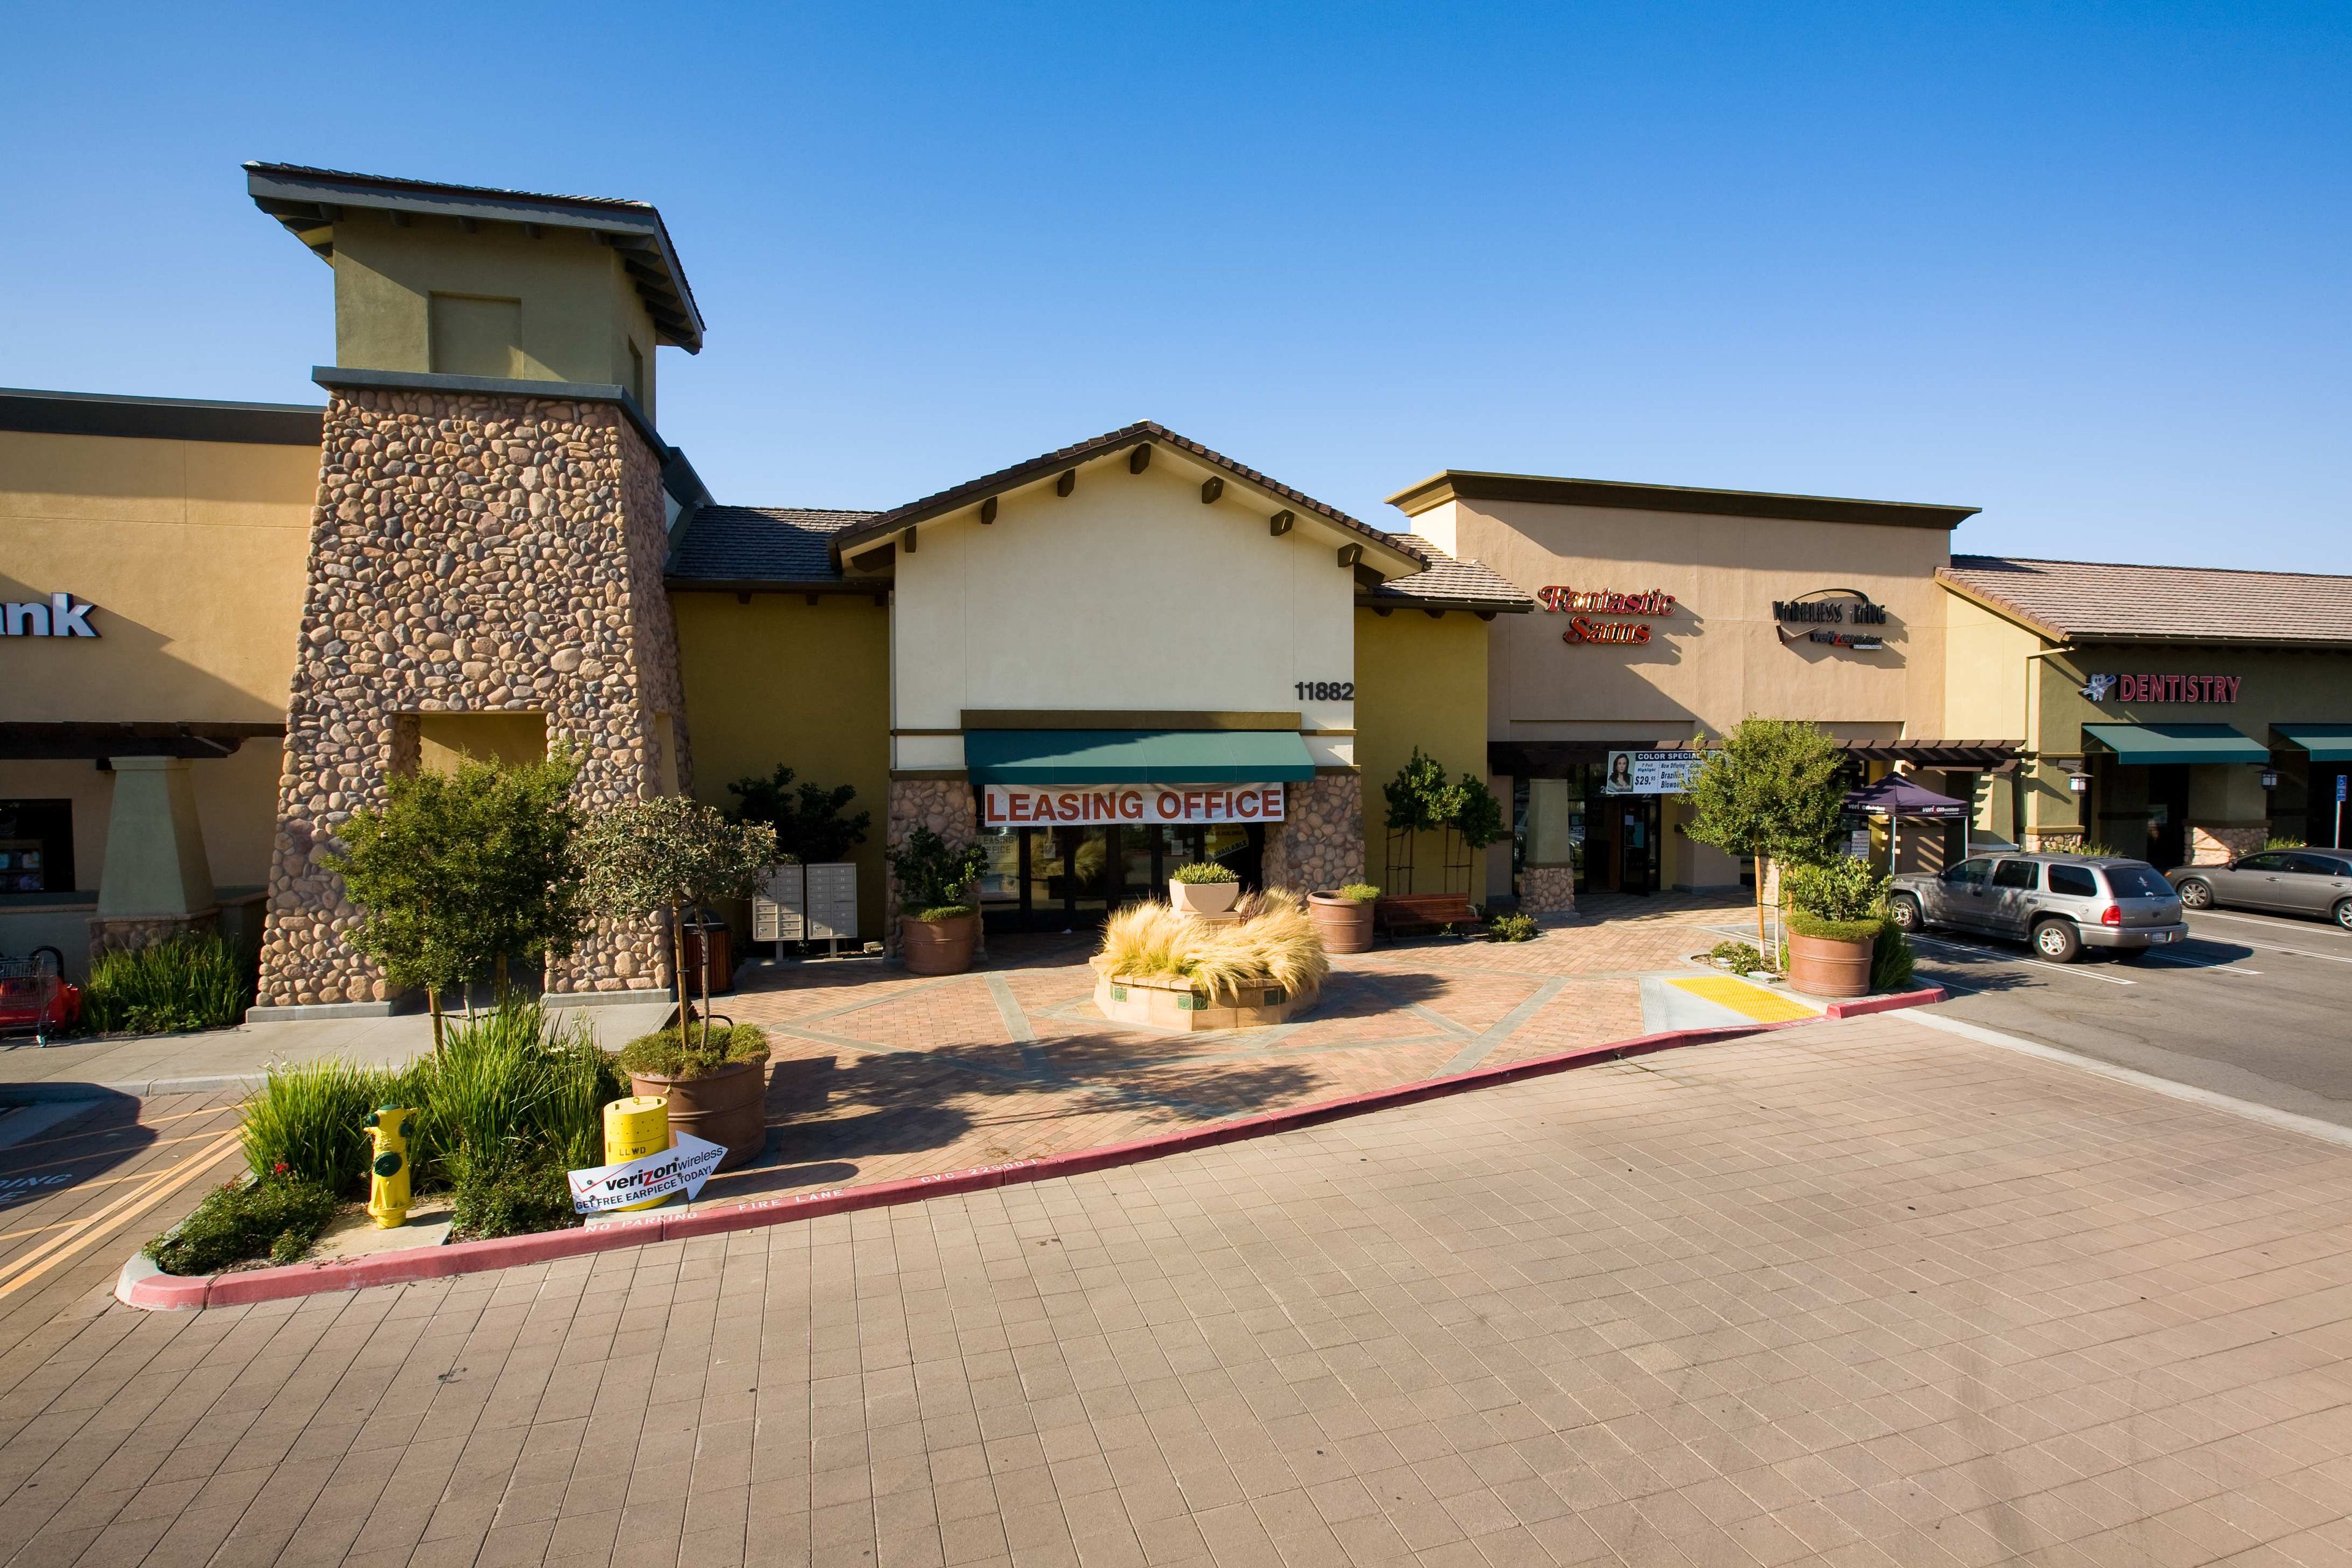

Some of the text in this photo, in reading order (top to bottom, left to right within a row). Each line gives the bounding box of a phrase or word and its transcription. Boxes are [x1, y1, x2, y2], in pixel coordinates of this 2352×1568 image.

[1538, 586, 1676, 616] Fantastic
[0, 592, 98, 637] nk
[1563, 616, 1652, 644] Sams
[1295, 682, 1354, 701] 11882
[2120, 674, 2242, 703] DENTISTRY
[986, 790, 1282, 822] LEASING OFFICE
[978, 836, 1014, 845] LEASING
[985, 845, 1011, 854] FFICE
[1214, 840, 1248, 858] AVAILABLE
[576, 1166, 712, 1209] GET FREE EARPIECE TODAY!
[920, 1172, 955, 1183] CVC
[738, 1189, 844, 1211] FIRE LANE
[584, 1212, 699, 1234] NO PARKING
